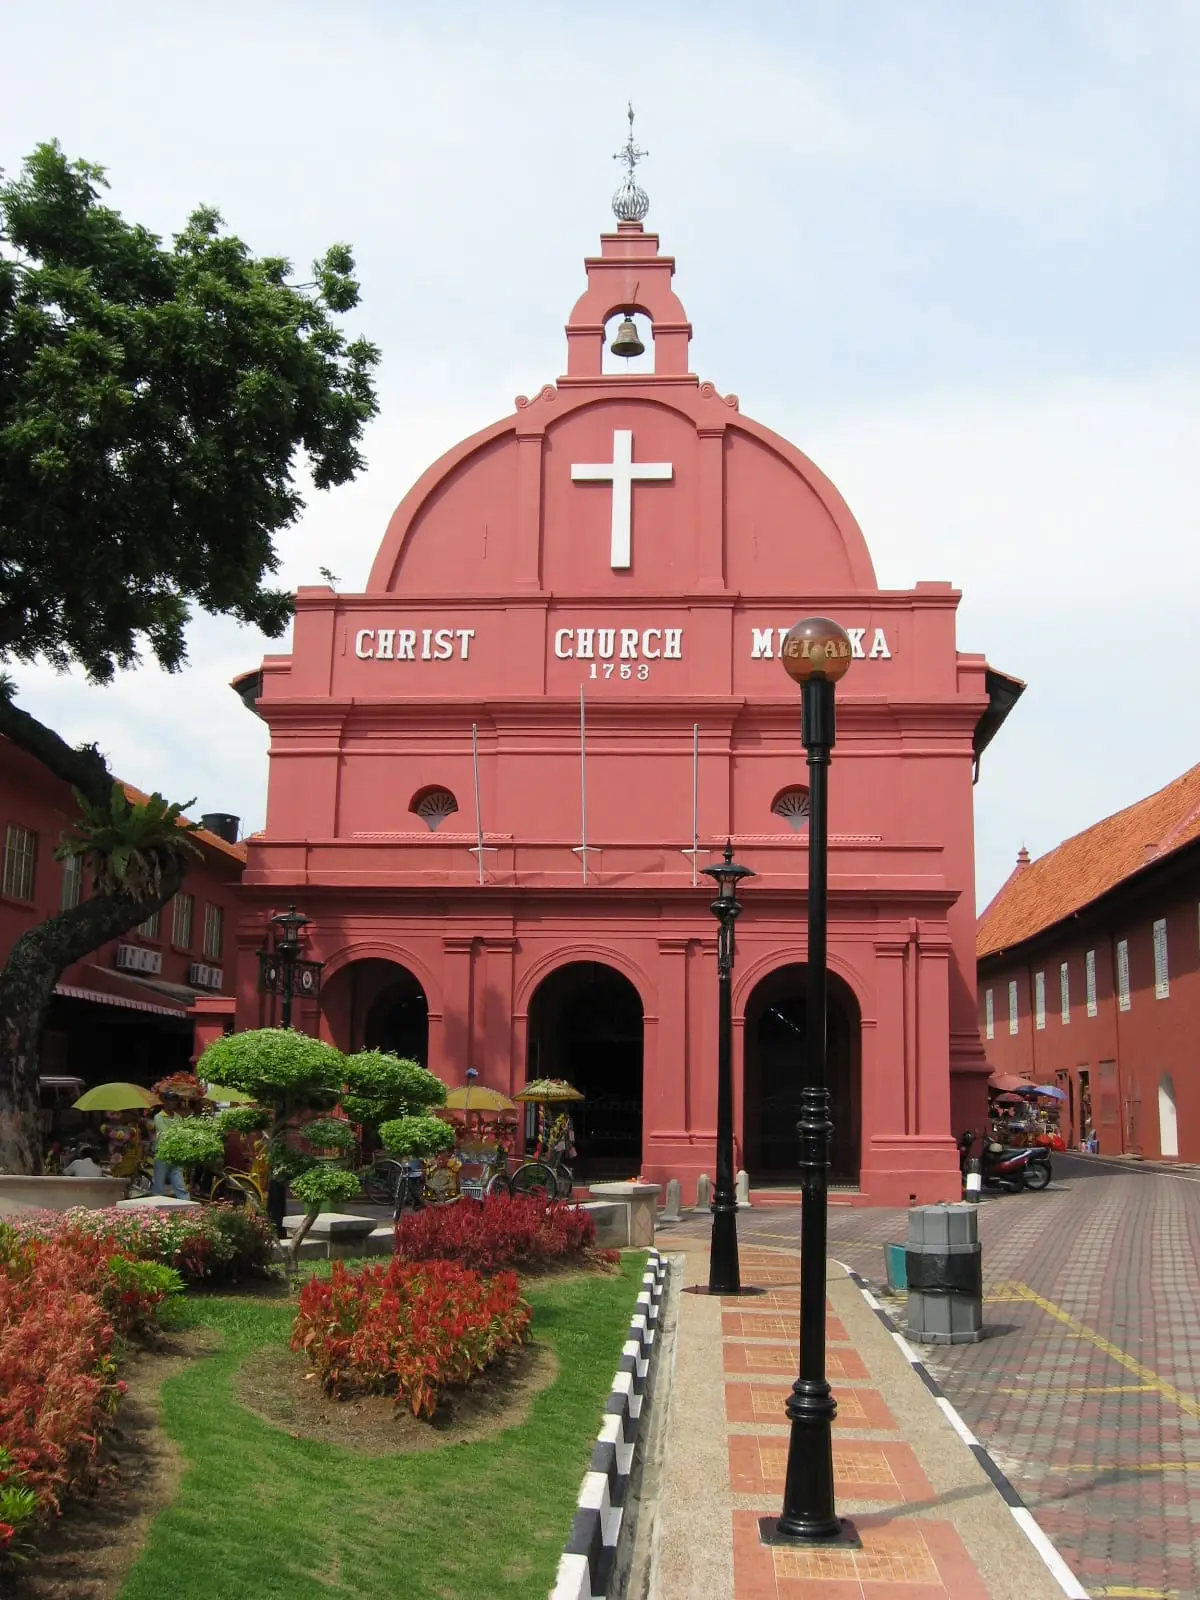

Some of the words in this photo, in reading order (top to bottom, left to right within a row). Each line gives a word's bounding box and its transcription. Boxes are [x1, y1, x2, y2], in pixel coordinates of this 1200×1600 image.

[355, 629, 475, 659] CHRIST
[554, 628, 683, 659] CHURCH
[589, 663, 649, 680] 1753
